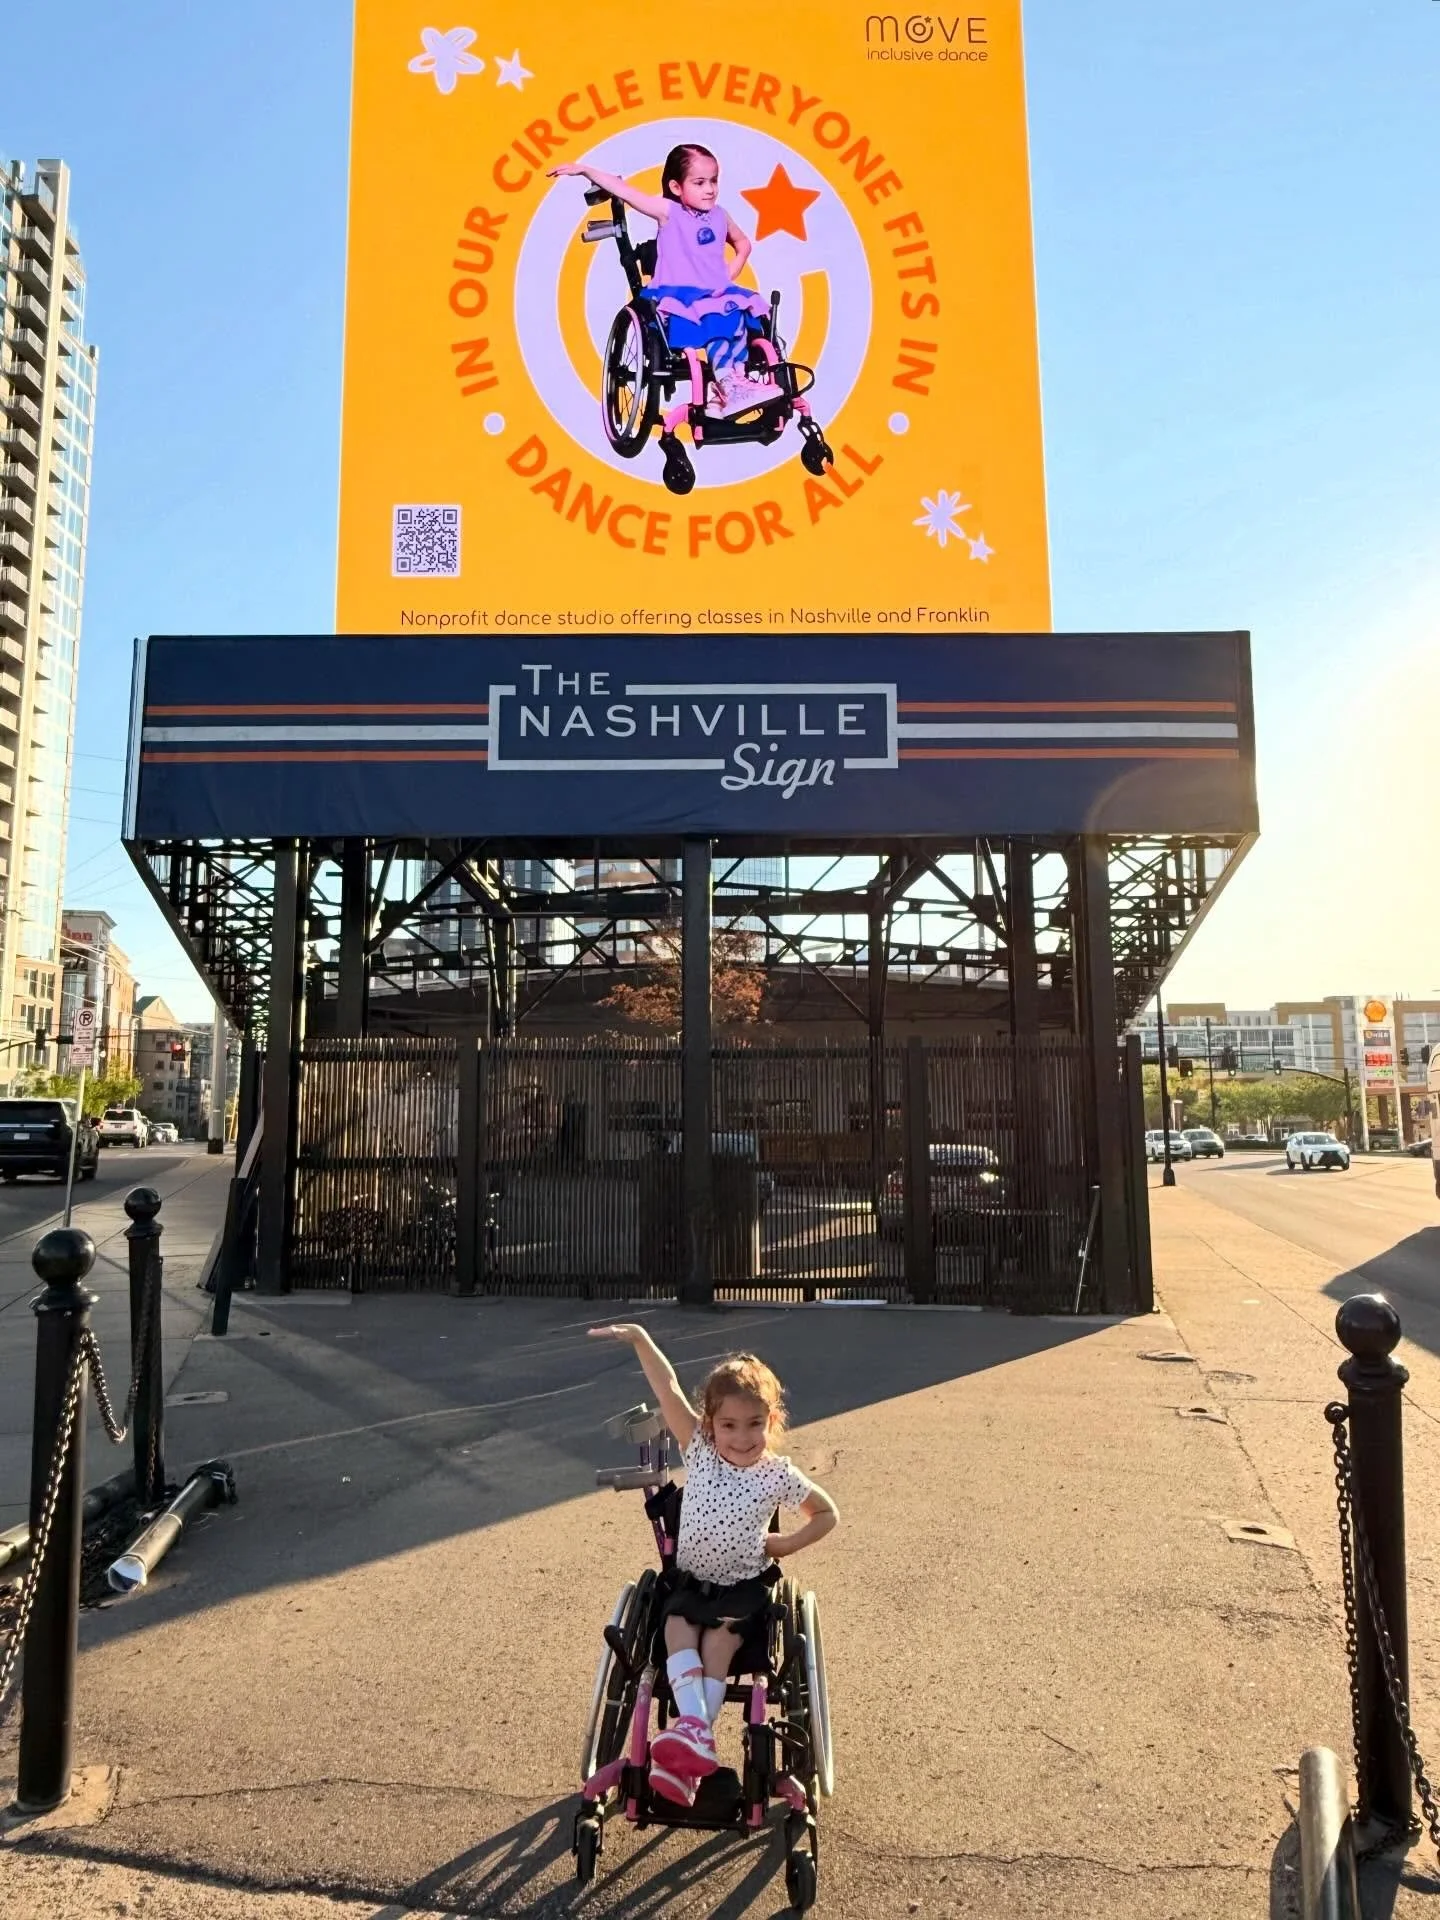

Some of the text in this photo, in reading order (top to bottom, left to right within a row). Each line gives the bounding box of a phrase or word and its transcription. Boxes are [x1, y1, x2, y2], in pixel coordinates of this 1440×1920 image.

[866, 15, 988, 44] MOVE
[867, 47, 989, 61] inclusive dance
[448, 60, 941, 397] IN OUR CIRCLE EVERYONE FITS IN
[506, 433, 885, 558] DANCE FOR ALL
[400, 606, 990, 629] Nonprofit dance studio offering classes in Nashville and Franklin
[521, 664, 611, 696] THE
[519, 703, 867, 737] NASHVILLE
[720, 742, 835, 800] Sign
